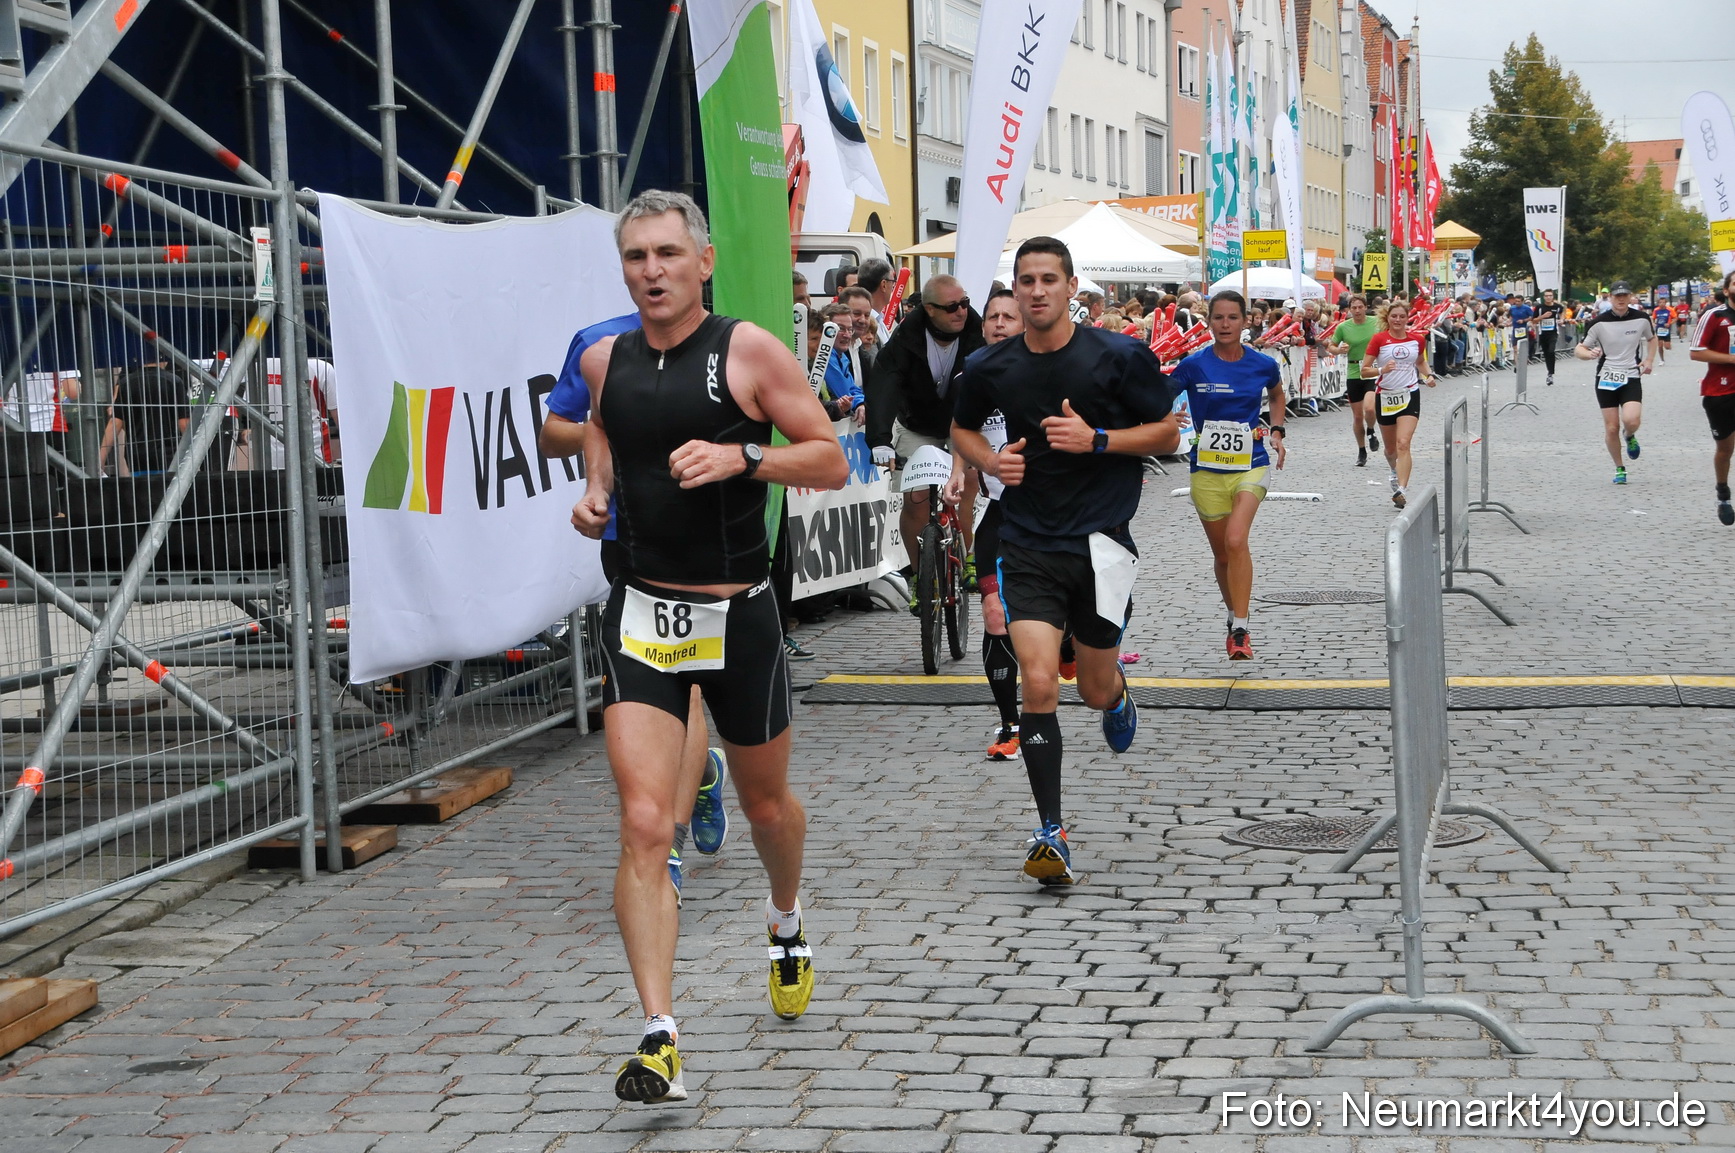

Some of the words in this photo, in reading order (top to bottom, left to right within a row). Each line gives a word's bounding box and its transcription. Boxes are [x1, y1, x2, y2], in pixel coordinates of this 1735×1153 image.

[986, 101, 1024, 204] Audi
[1011, 3, 1046, 93] BKK
[1714, 173, 1729, 212] BKK
[1245, 239, 1284, 247] Schnupper-
[1081, 264, 1163, 273] www.audibkk.de
[1368, 264, 1382, 281] A
[814, 343, 832, 374] BMW
[706, 352, 721, 404] 2XU
[1603, 371, 1626, 383] 2459
[1387, 394, 1405, 406] 301
[463, 373, 586, 511] VAR
[1209, 432, 1244, 452] 235
[911, 461, 932, 471] Erste
[1215, 454, 1235, 464] Birgit
[747, 576, 770, 599] 2XU
[653, 601, 693, 639] 68
[645, 643, 697, 664] Manfred
